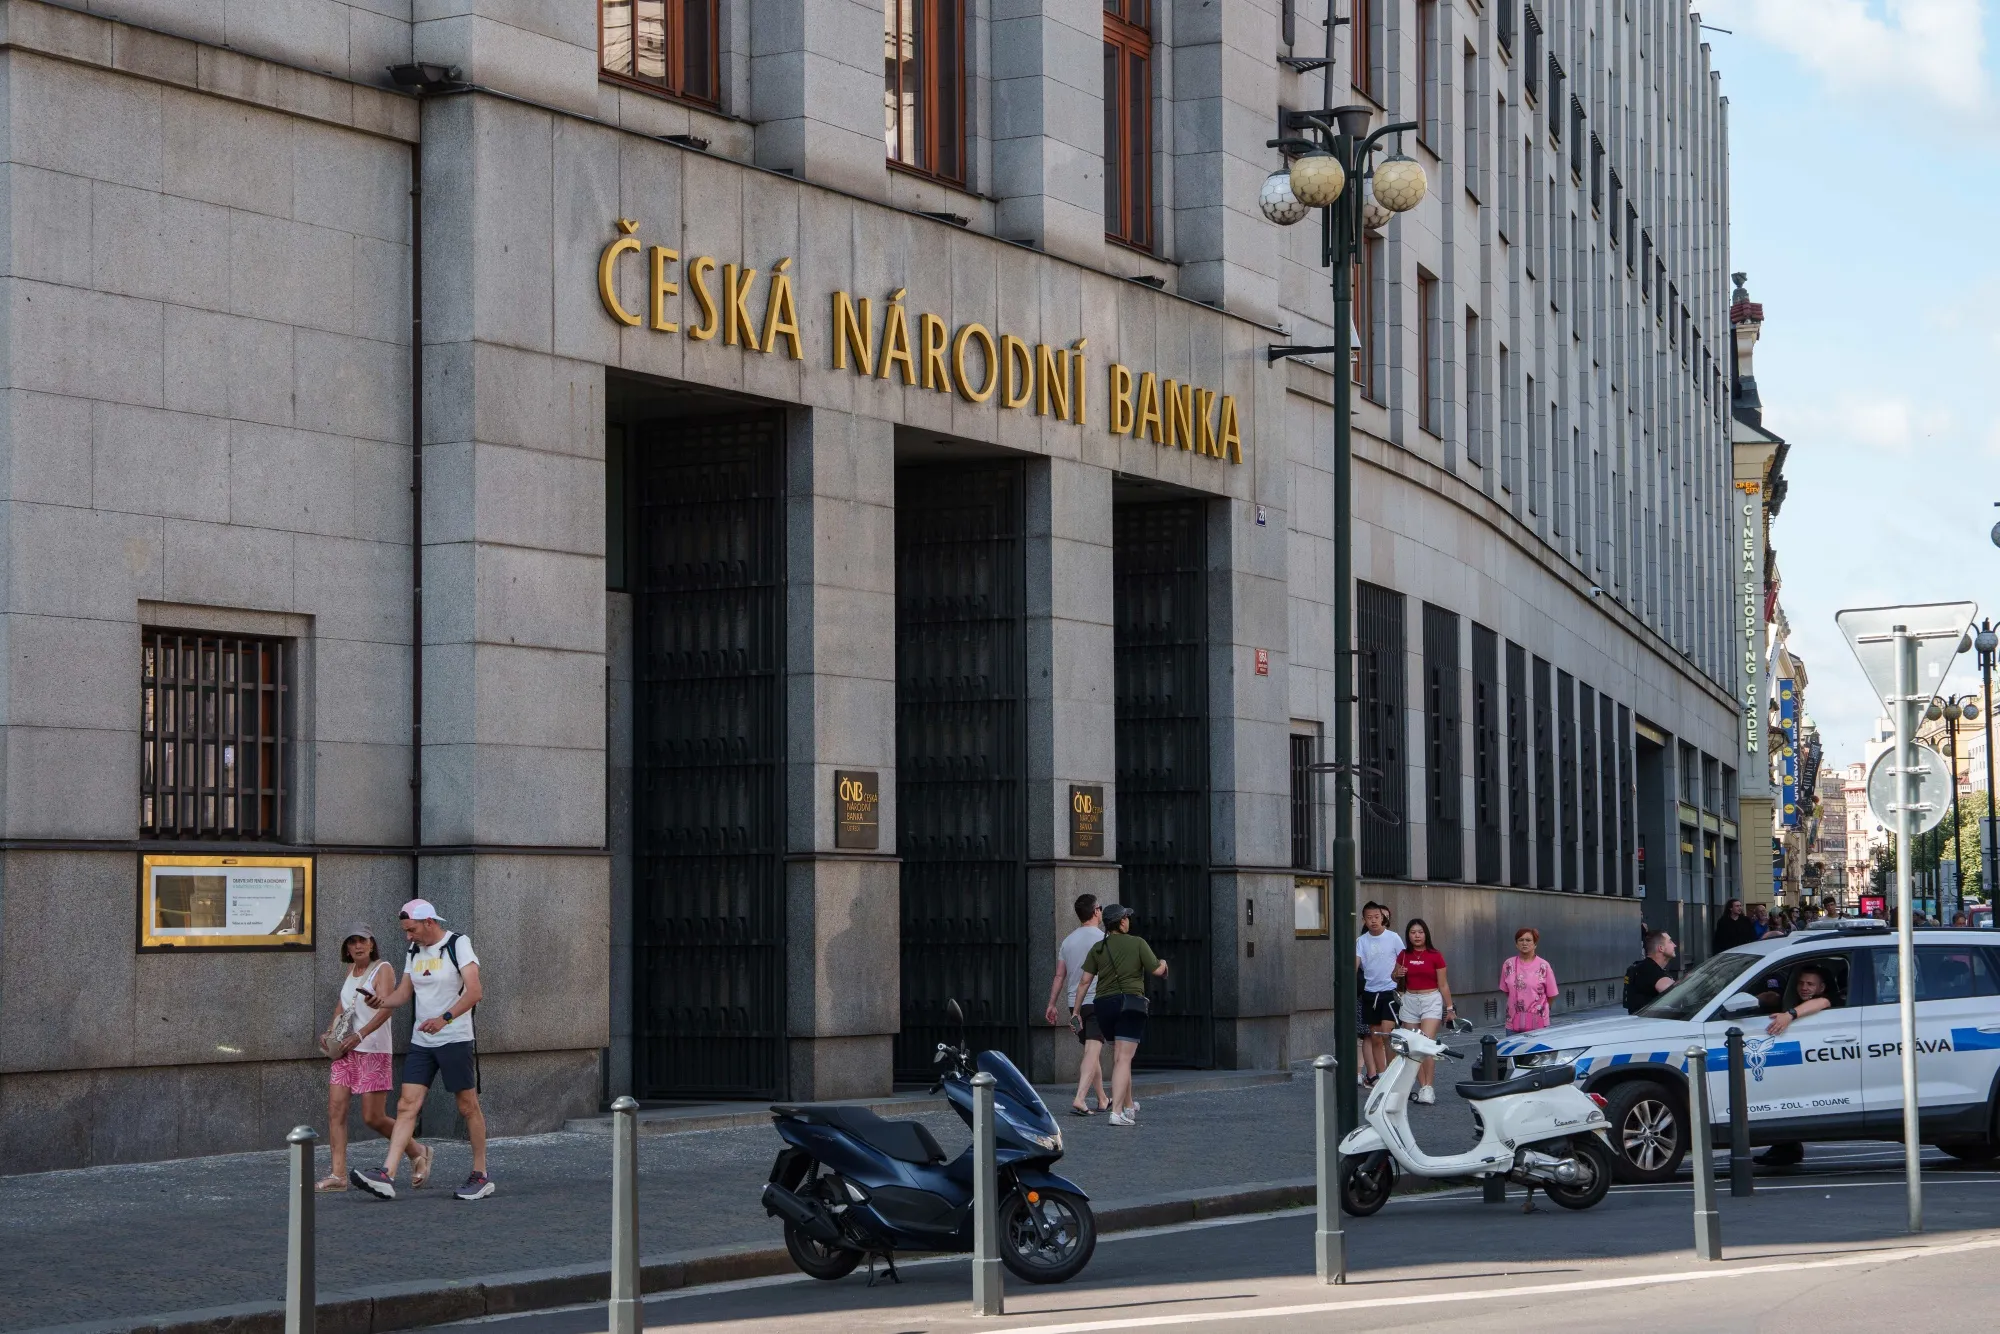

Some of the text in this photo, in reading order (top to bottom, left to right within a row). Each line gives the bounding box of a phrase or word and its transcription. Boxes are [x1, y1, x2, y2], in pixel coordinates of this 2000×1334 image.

[599, 218, 1243, 464] ČESKÁ NÁRODNÍ BANKA
[1743, 504, 1759, 753] CINEMA SHOPPING GARDEN
[840, 777, 878, 803] ČNB ČESKÁ
[846, 801, 871, 812] NÁRODNÍ
[1074, 791, 1092, 813] ČNB
[846, 812, 863, 821] BANKA
[1804, 1042, 1861, 1063] CELNÍ
[1781, 1101, 1804, 1110] ZOLL
[1812, 1097, 1851, 1107] DOUANE
